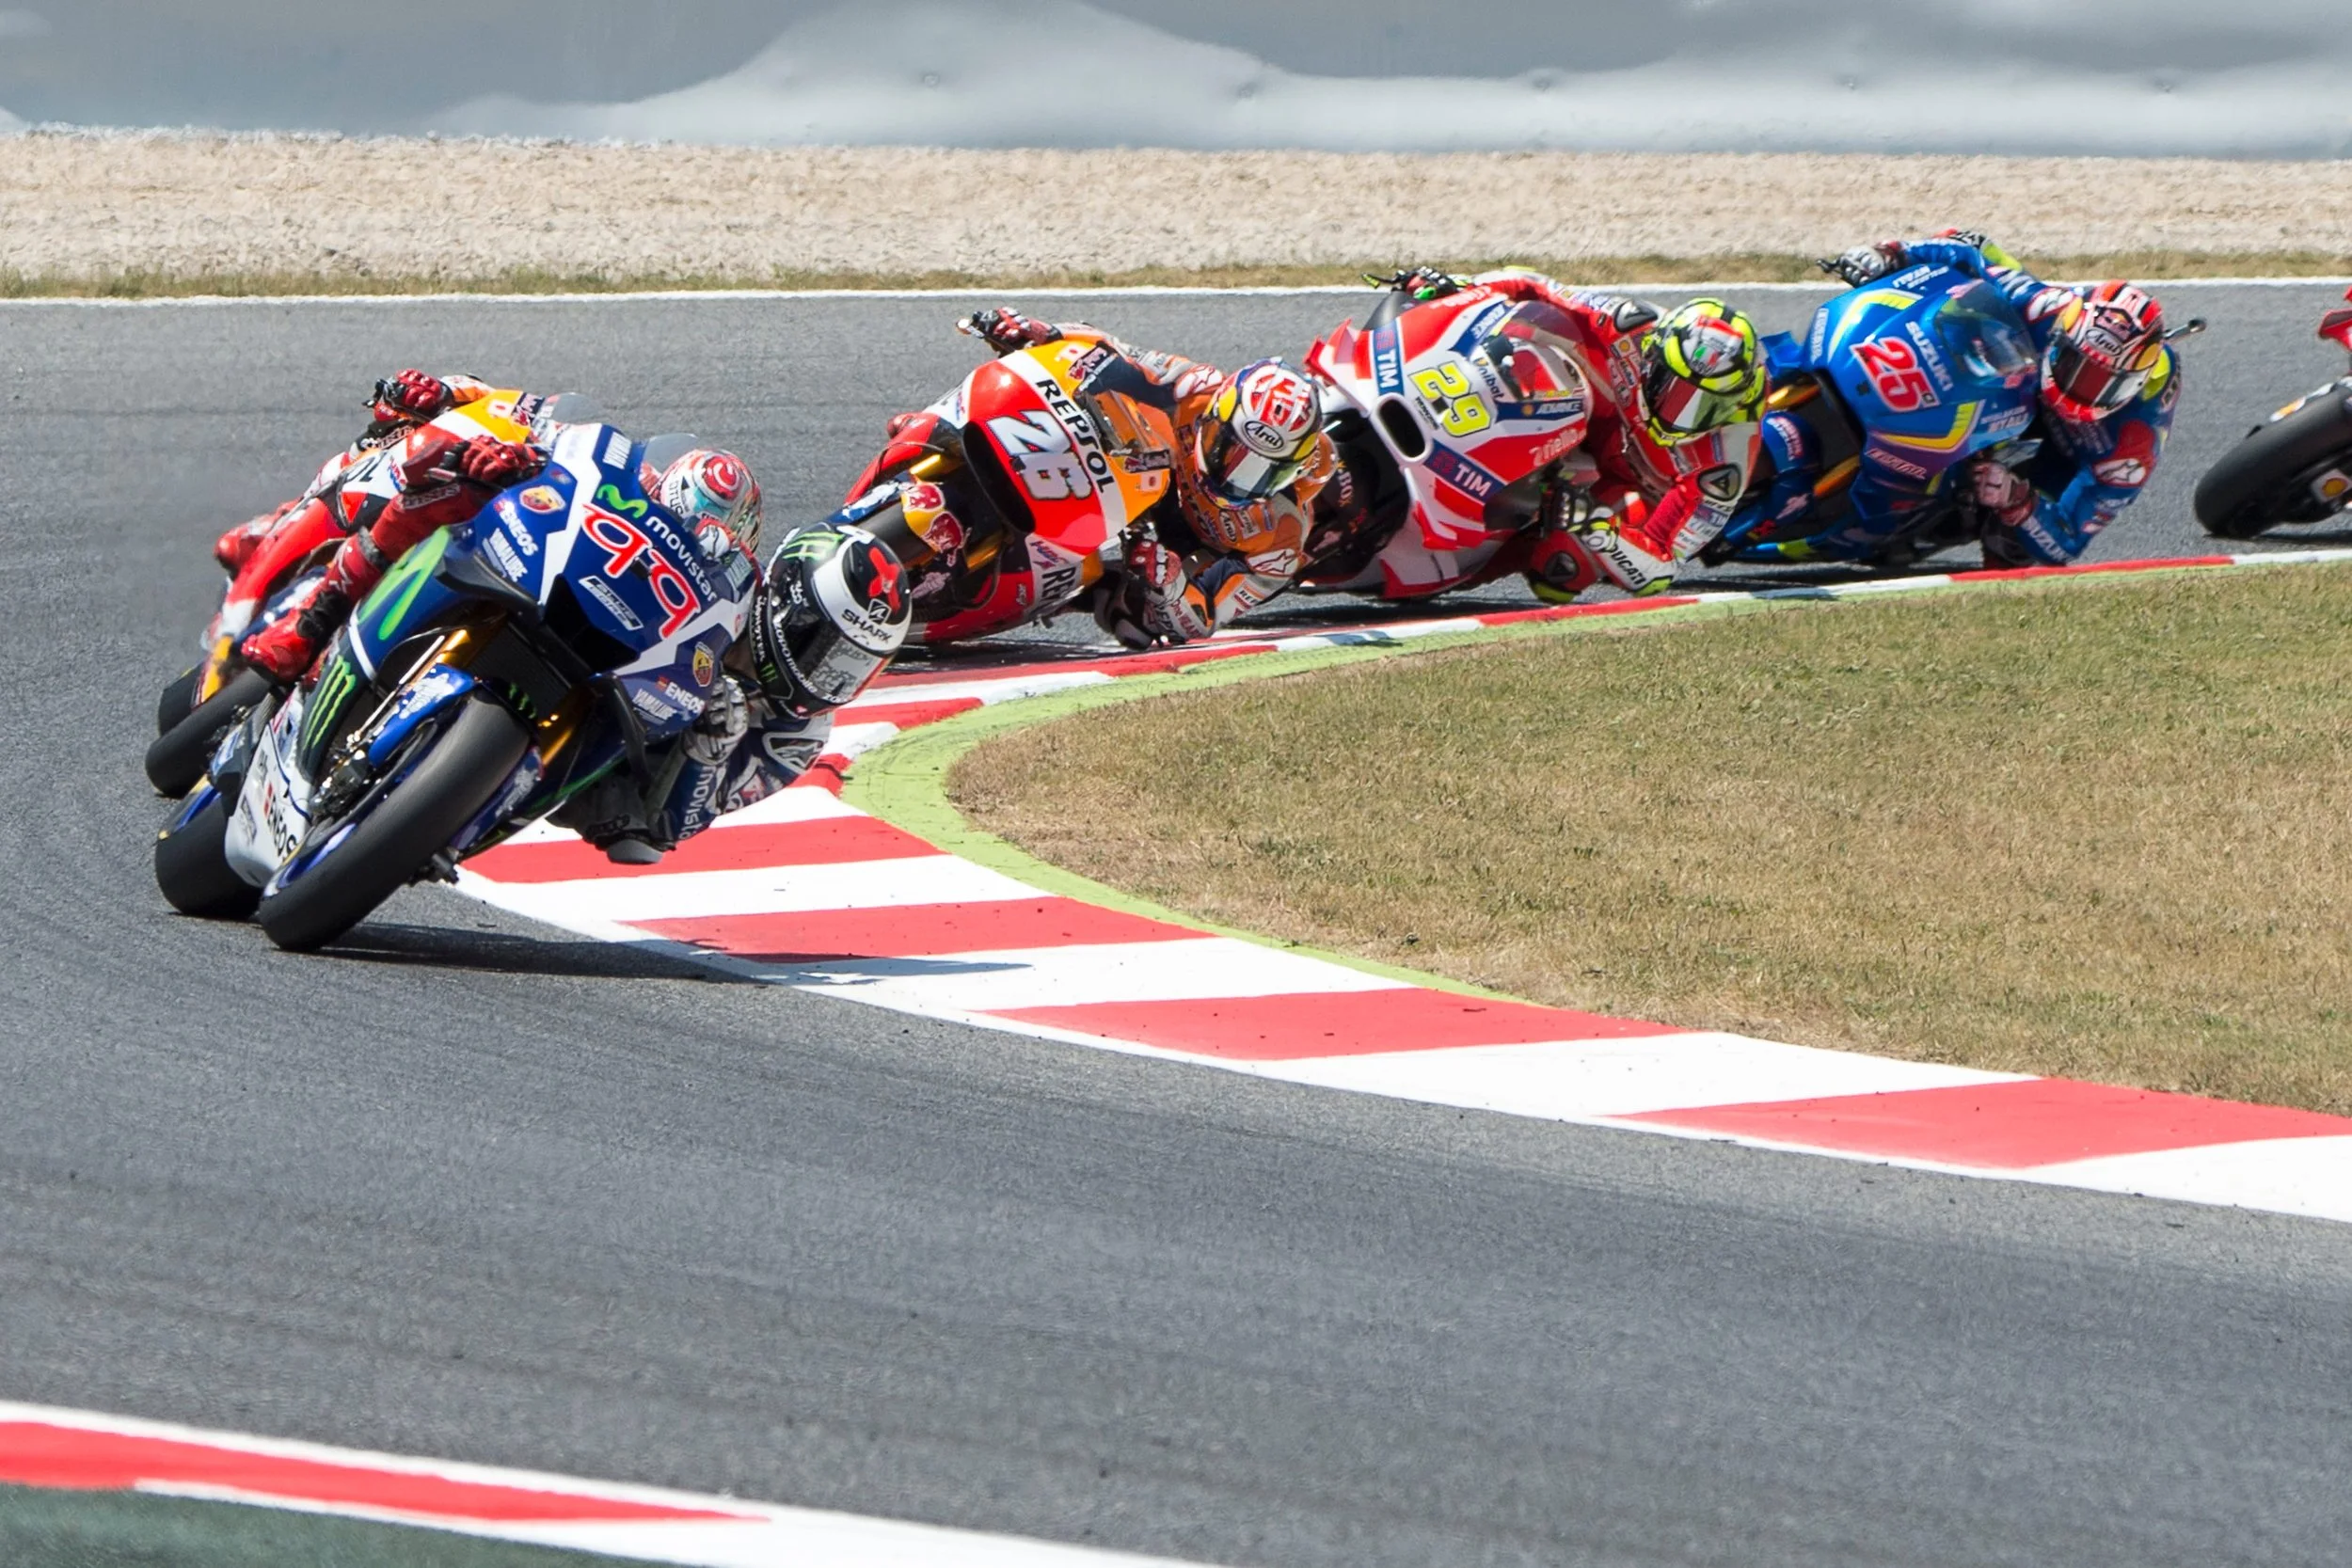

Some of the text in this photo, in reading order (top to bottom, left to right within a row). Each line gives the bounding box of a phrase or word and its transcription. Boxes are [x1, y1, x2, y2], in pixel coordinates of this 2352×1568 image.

[1376, 348, 1400, 388] TIM
[1850, 336, 1941, 412] 25
[1905, 321, 1954, 392] SUZUKI
[1407, 360, 1491, 438] 29
[986, 410, 1095, 500] 26
[1036, 379, 1115, 494] REPSOL
[1247, 424, 1279, 448] Arai
[1454, 464, 1492, 497] TIM
[580, 501, 702, 641] 99
[644, 515, 719, 603] movistar
[841, 609, 892, 641] SHARK
[665, 682, 706, 714] ENEOS
